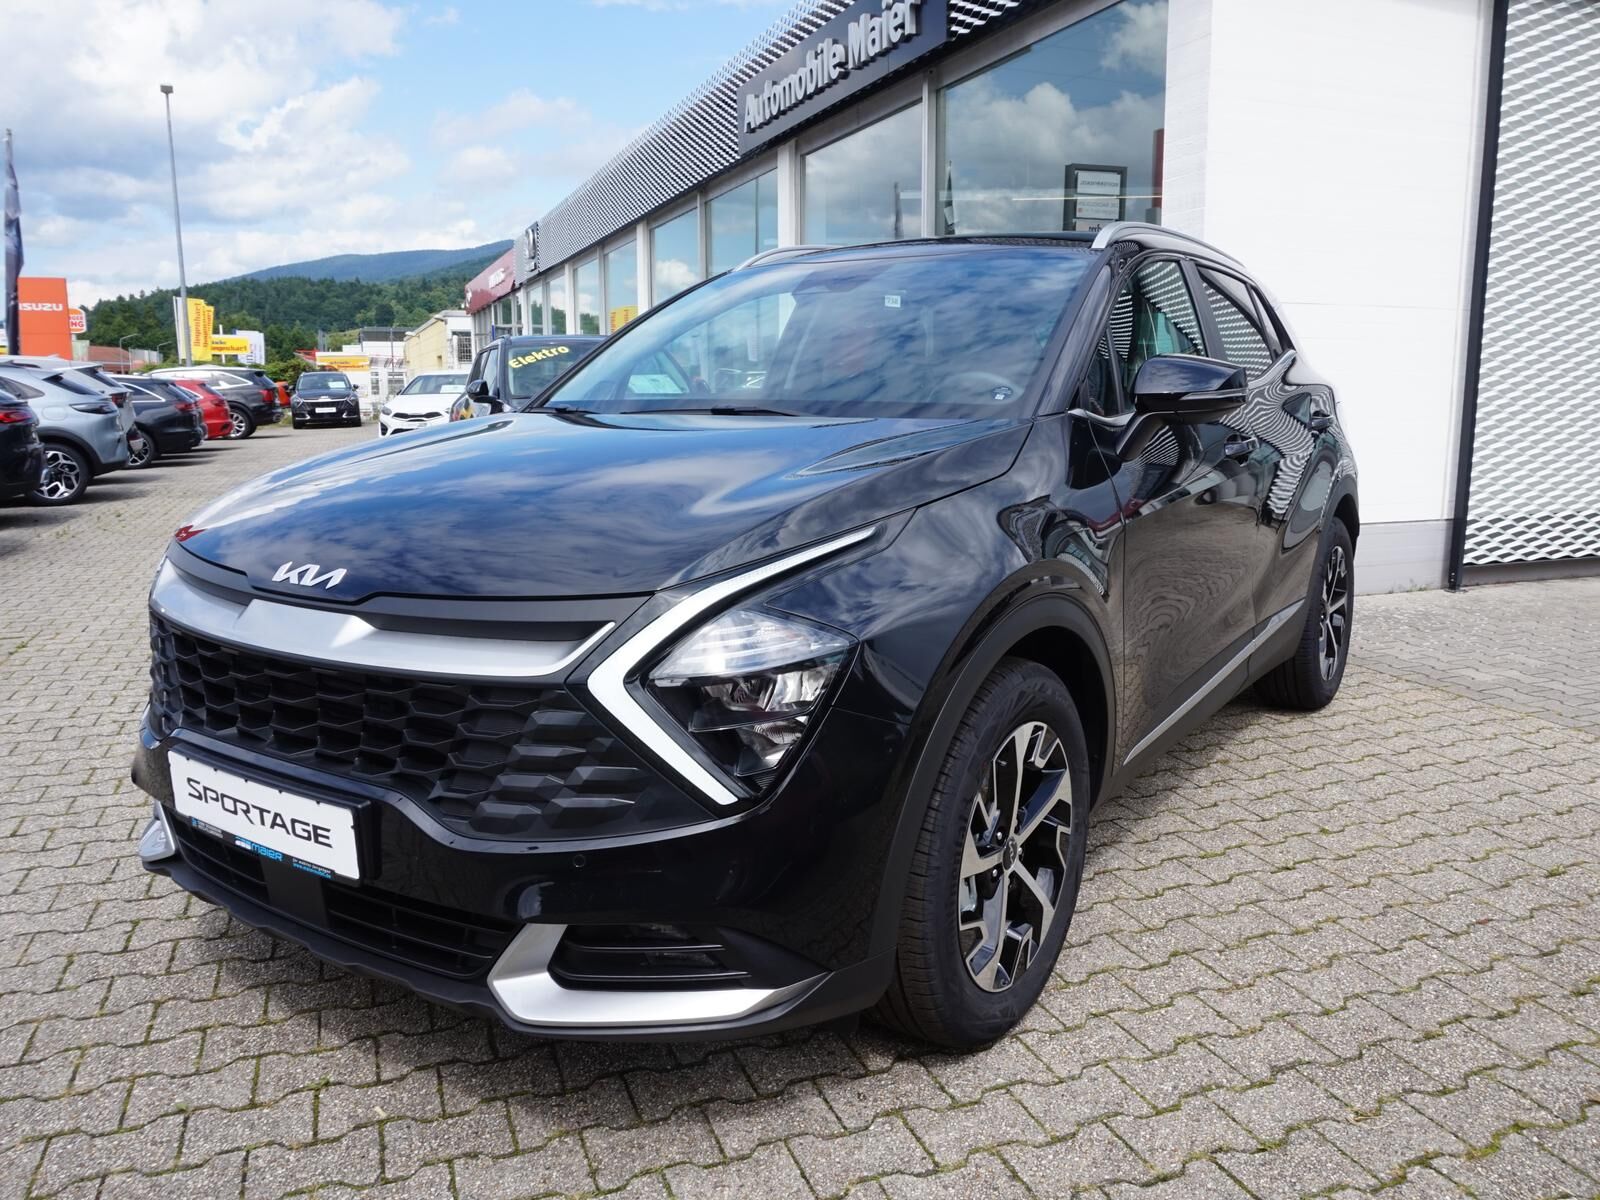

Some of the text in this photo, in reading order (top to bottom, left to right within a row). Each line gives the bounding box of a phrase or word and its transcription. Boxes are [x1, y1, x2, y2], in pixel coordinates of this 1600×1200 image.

[743, 0, 922, 134] Automobile Maier
[18, 303, 64, 311] ISUZU
[508, 345, 570, 369] Elektro
[186, 776, 333, 849] SPORTAGE
